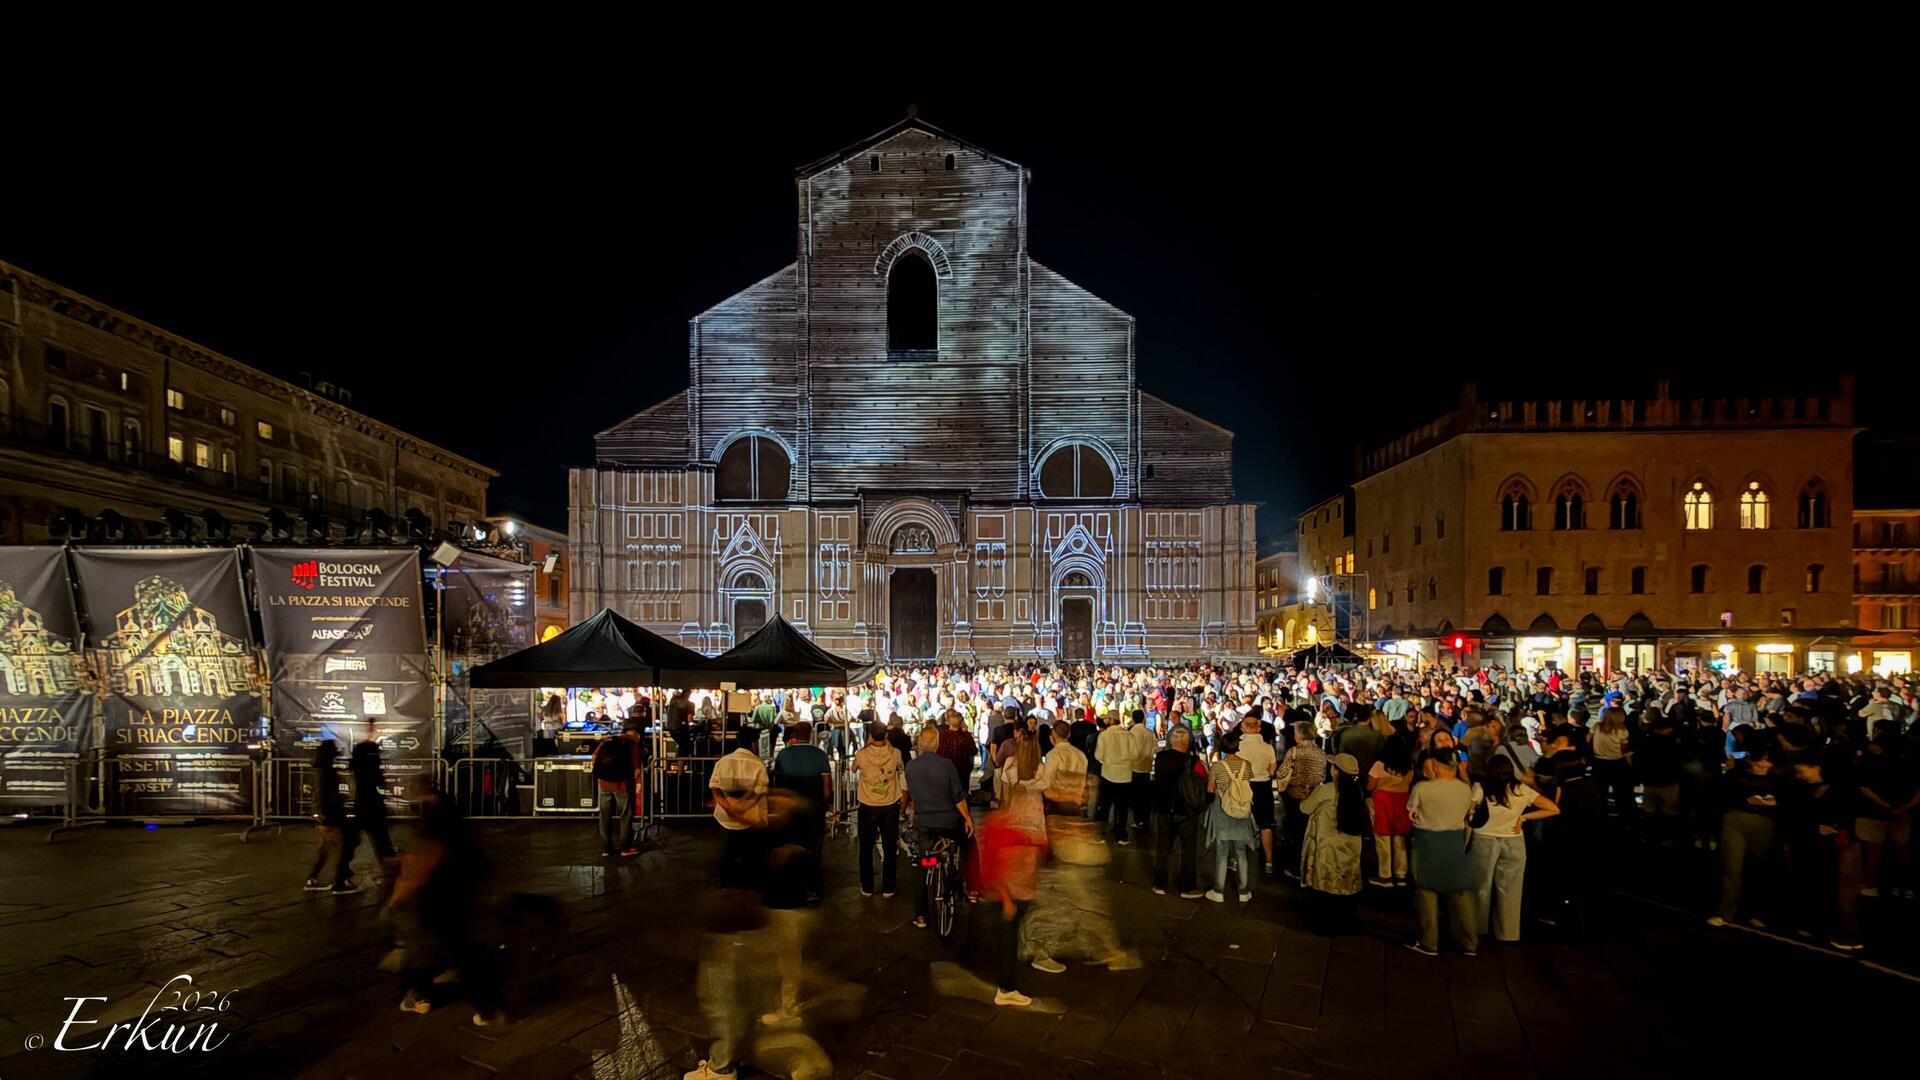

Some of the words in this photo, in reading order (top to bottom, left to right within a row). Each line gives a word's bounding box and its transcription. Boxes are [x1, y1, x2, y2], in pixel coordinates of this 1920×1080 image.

[318, 562, 381, 575] BOLOGNA
[320, 575, 375, 588] FESTIVAL
[270, 595, 285, 606] LA
[288, 595, 329, 607] PIAZZA
[331, 595, 342, 607] SI
[345, 595, 410, 608] RIACCENDE
[0, 707, 64, 724] IAZZA
[128, 709, 155, 725] LA
[162, 708, 234, 725] PIAZZA
[116, 728, 132, 744] SI
